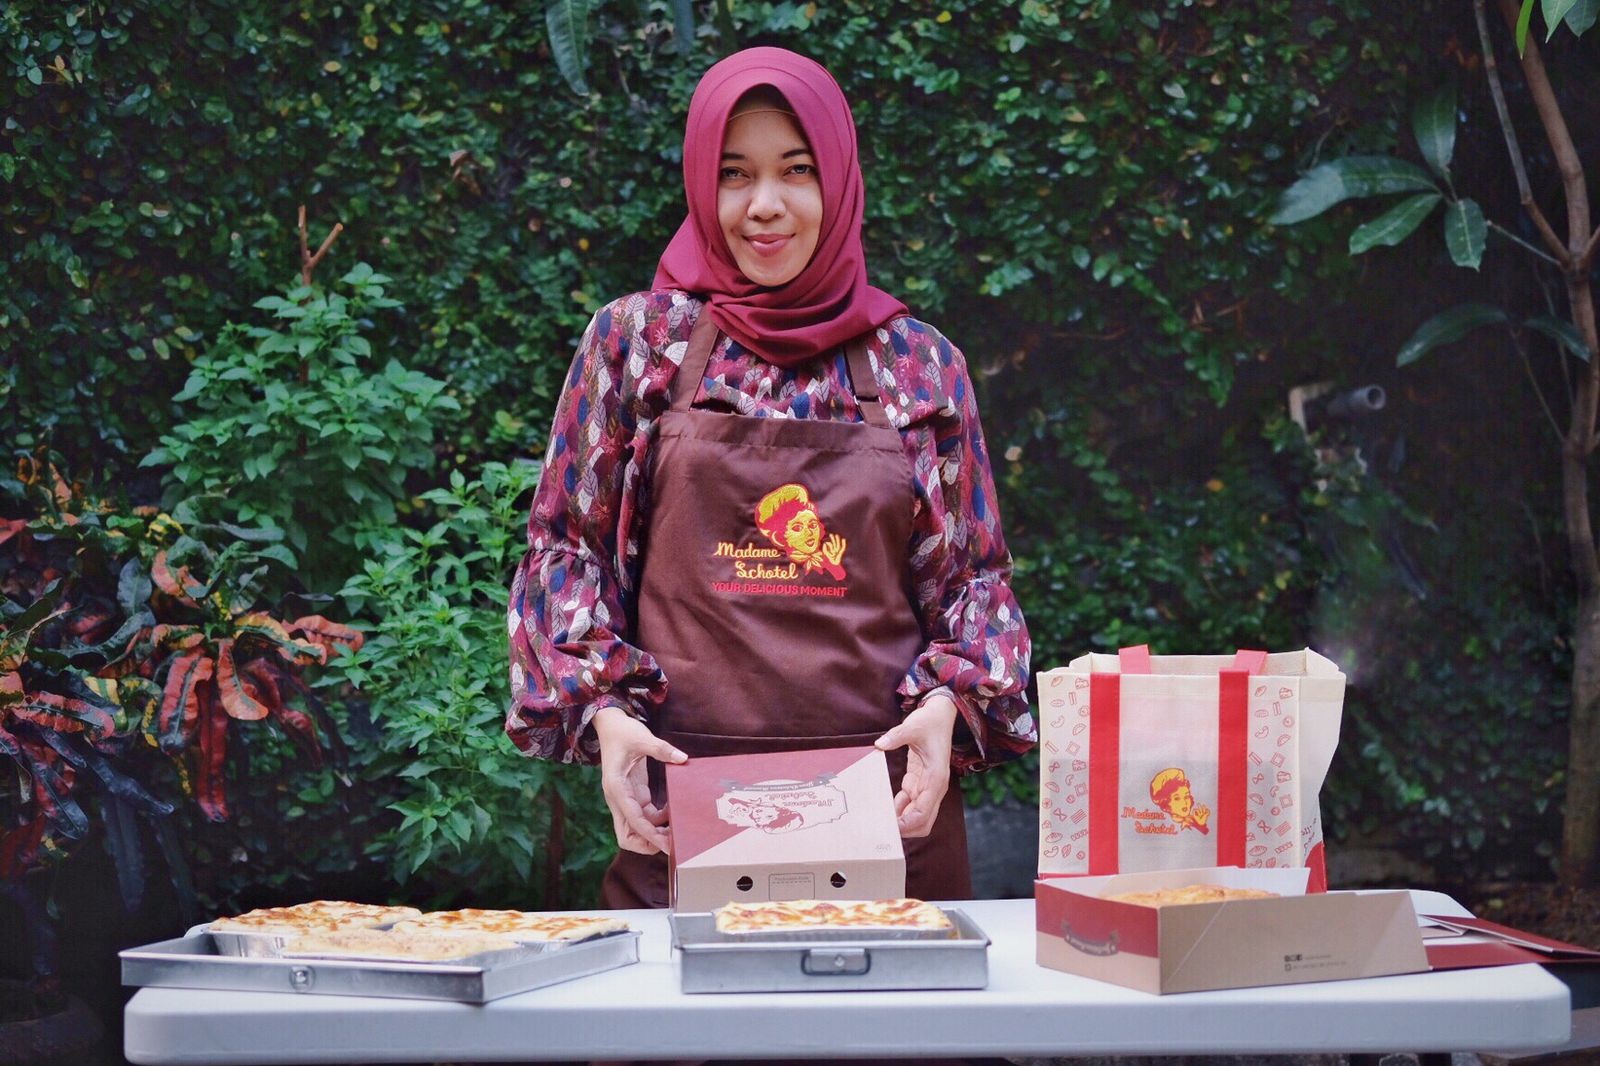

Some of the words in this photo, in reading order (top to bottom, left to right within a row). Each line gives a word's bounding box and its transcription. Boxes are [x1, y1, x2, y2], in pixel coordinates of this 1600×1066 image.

[713, 541, 781, 559] Madame
[735, 560, 799, 580] Schotel
[711, 582, 741, 593] YOUR
[743, 583, 799, 595] DELICIOUS
[800, 585, 848, 597] MOMENT
[1121, 806, 1167, 820] Madame
